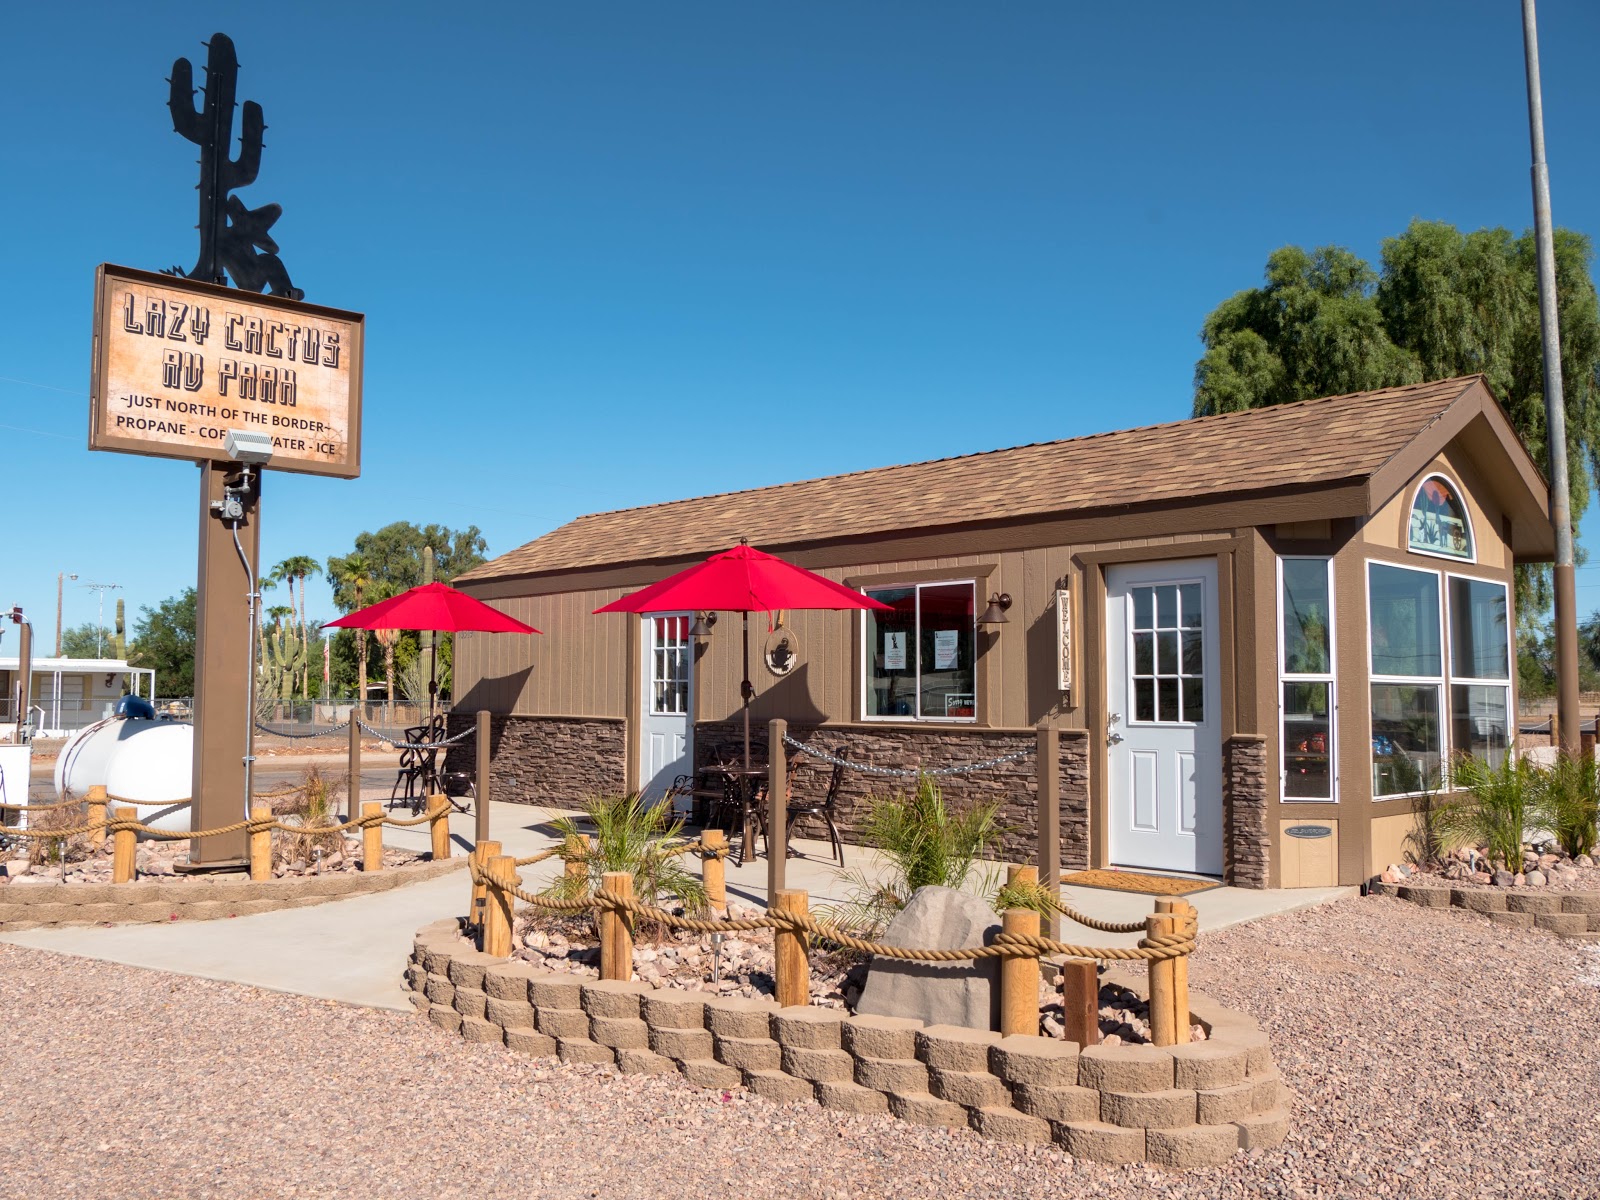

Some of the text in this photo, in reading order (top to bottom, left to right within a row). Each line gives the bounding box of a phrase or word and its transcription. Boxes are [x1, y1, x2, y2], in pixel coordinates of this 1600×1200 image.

[123, 292, 341, 369] LAZY CACTUS
[161, 348, 297, 407] RV PARK
[116, 415, 187, 435] PROPANE
[199, 426, 226, 440] COF
[271, 435, 306, 451] ATER
[316, 442, 335, 455] ICE
[166, 400, 217, 417] NORTH
[220, 407, 239, 420] OF
[242, 410, 268, 424] THE
[1061, 597, 1070, 683] WELCOME
